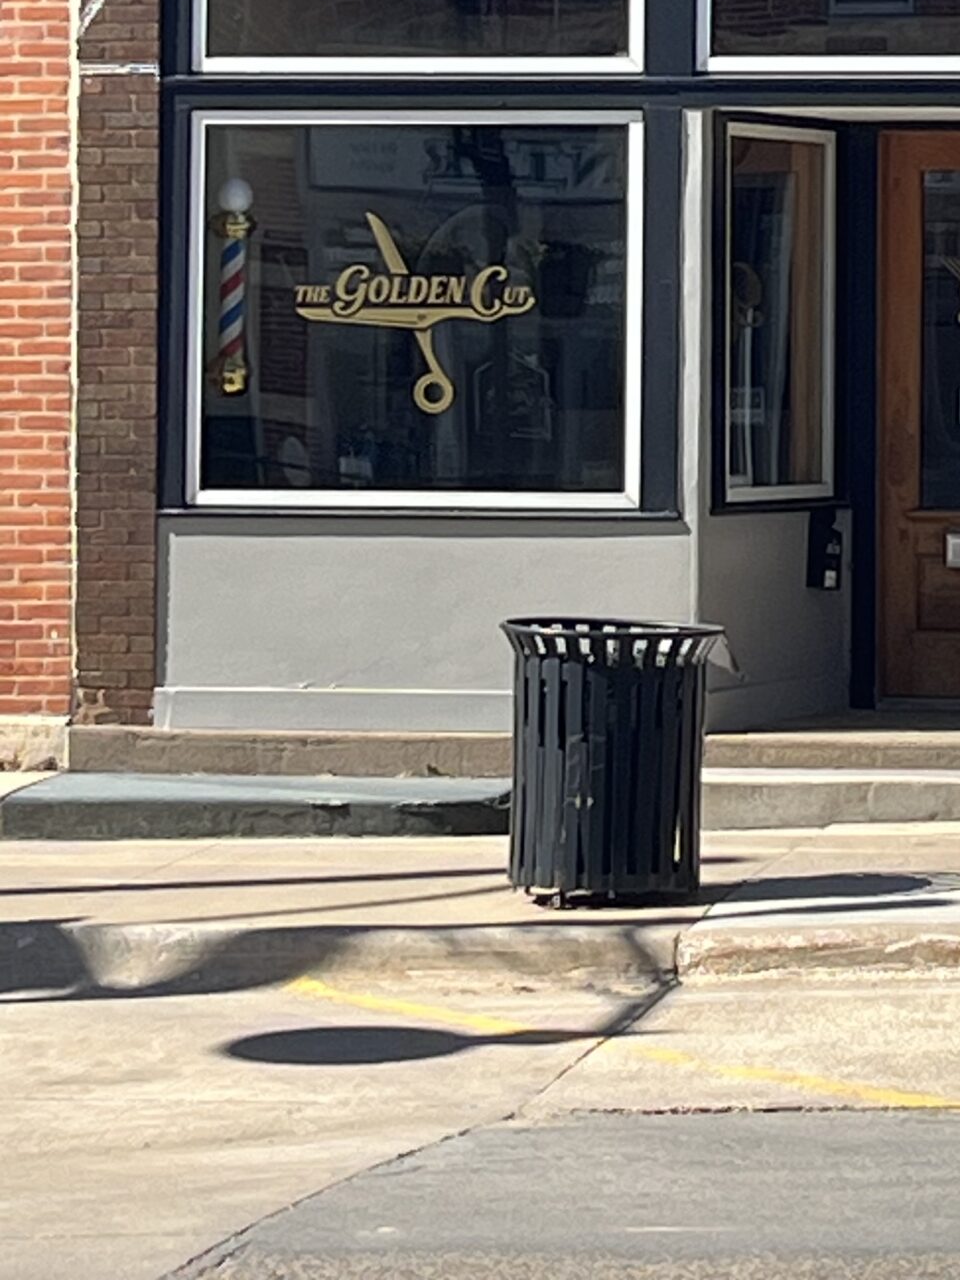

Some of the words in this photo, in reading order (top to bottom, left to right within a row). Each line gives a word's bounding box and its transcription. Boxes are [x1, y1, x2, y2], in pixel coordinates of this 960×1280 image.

[295, 285, 331, 304] THE
[332, 265, 466, 316] GOLDEN
[471, 265, 532, 316] CUT
